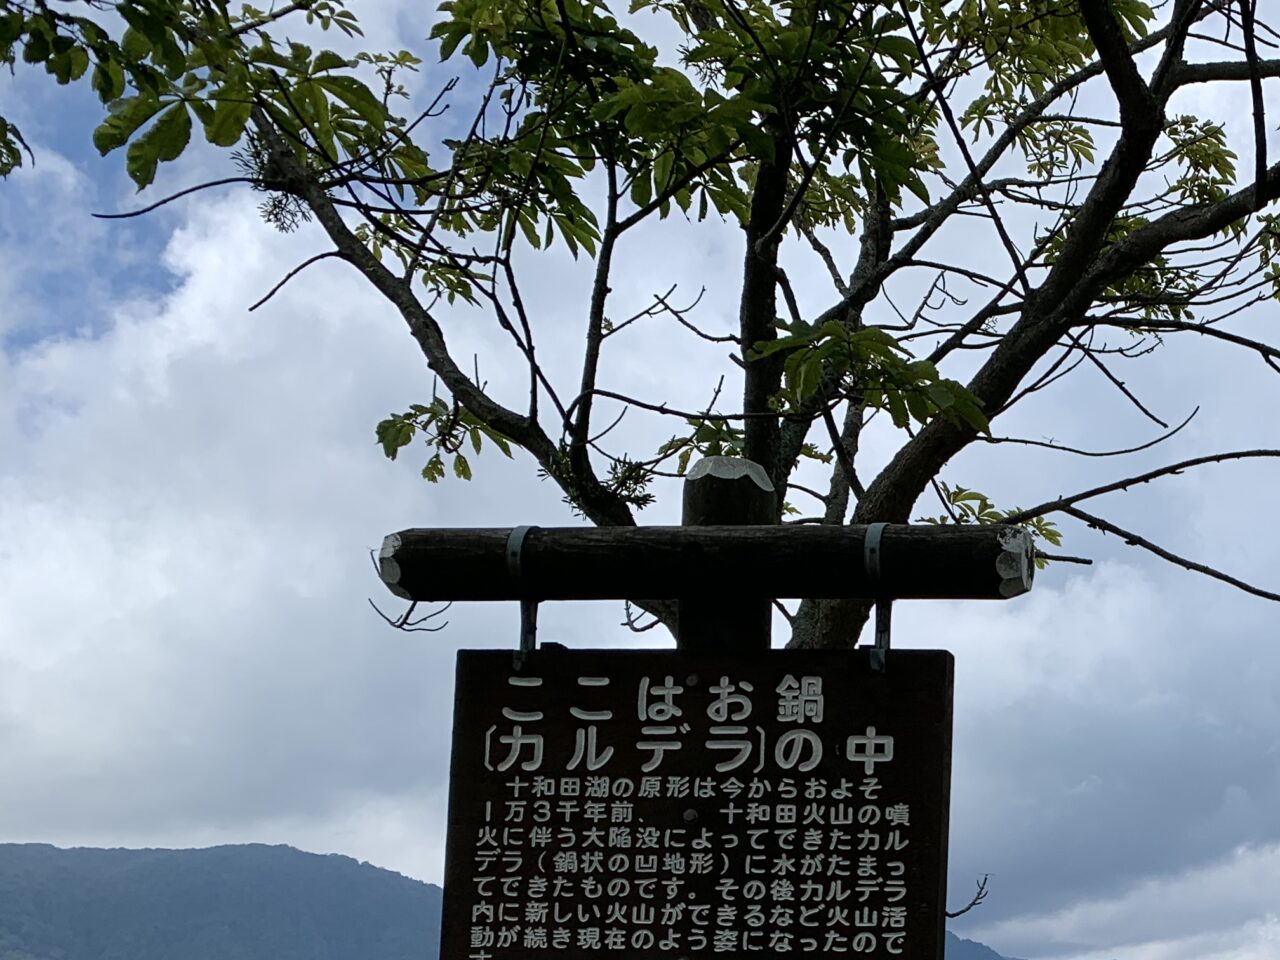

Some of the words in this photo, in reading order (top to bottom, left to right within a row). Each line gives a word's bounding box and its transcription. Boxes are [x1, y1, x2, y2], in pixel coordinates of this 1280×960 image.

[502, 674, 824, 723] ここはお鍋
[506, 776, 883, 800] 十和田湖の原形は今からおよそ
[476, 826, 910, 851] 火に伴う大陥没によってできたカル
[473, 876, 907, 902] てできたものです。その後カルデラ
[472, 902, 908, 927] 内に新しい火山ができるなど火山活
[471, 926, 907, 953] 動が続き現在のよう姿になったので
